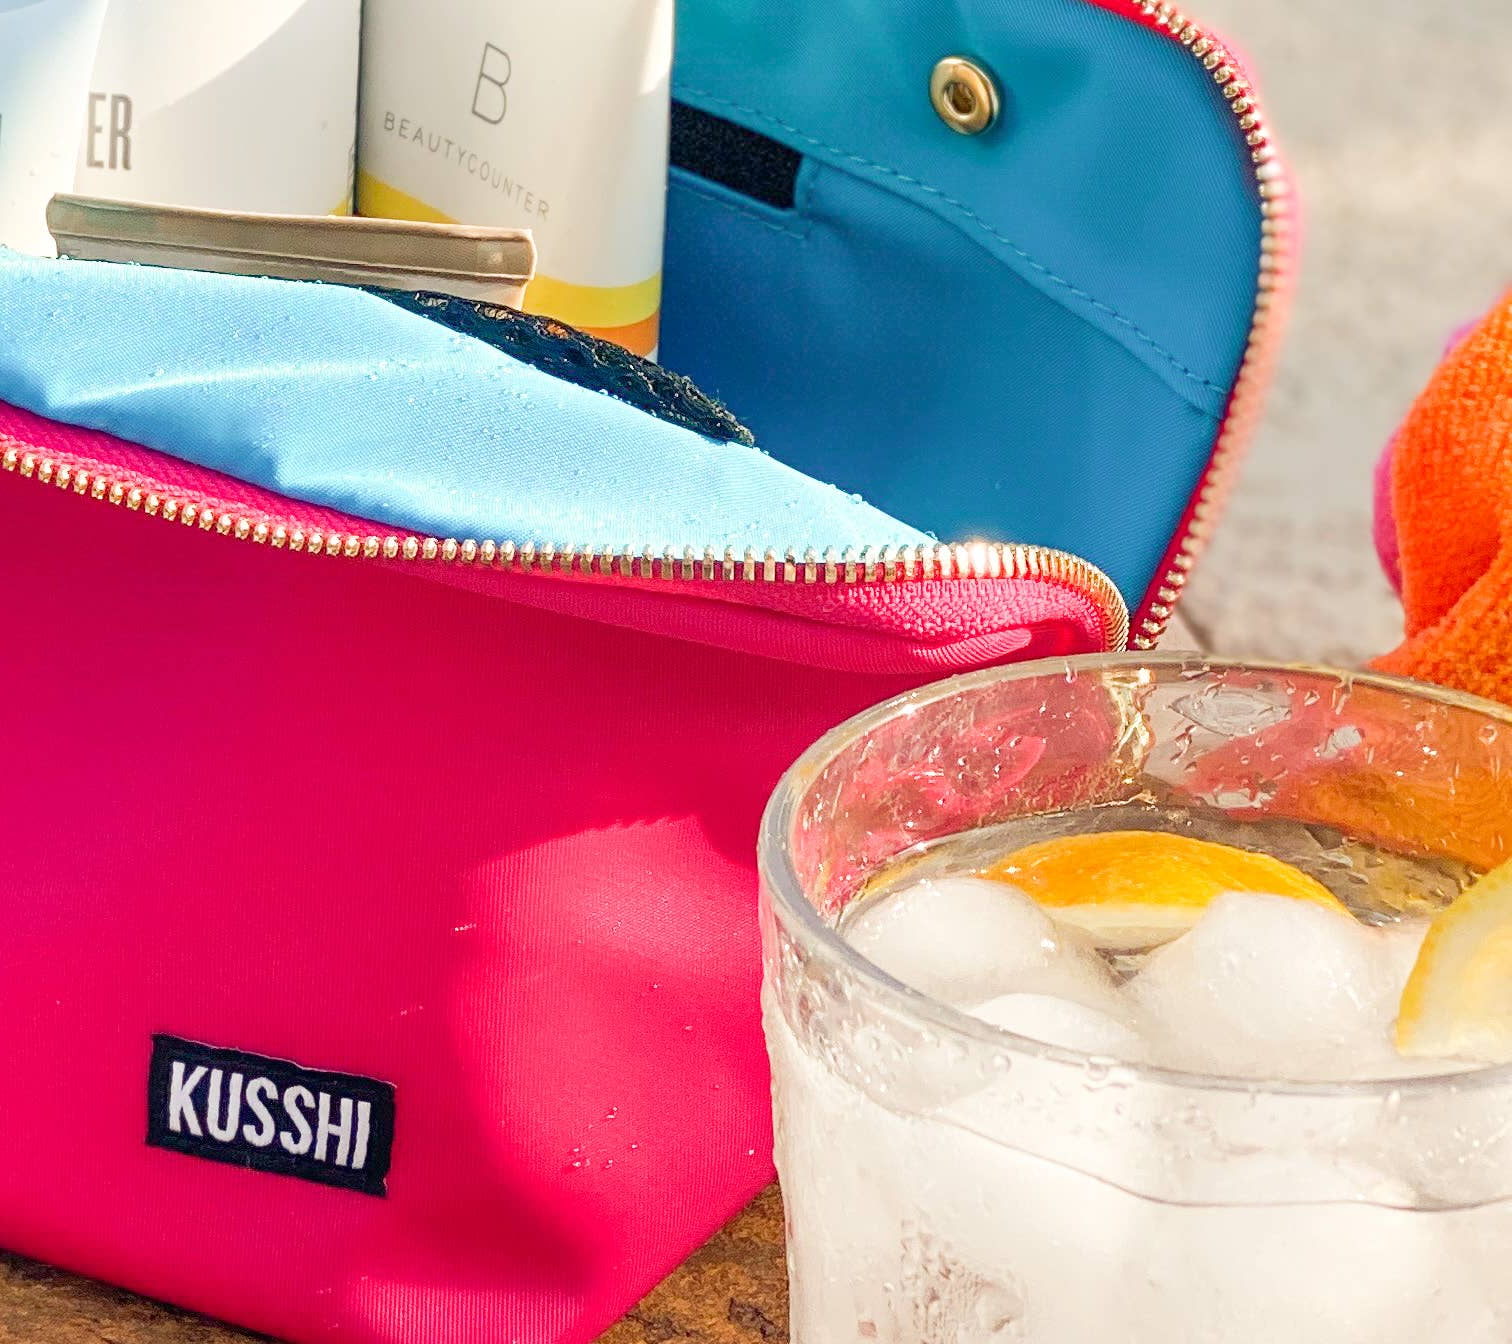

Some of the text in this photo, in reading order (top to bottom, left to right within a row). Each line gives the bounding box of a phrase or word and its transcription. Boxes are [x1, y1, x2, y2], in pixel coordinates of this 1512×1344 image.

[471, 41, 512, 125] B
[383, 111, 551, 222] BEAUTYCOUNTER
[169, 1061, 372, 1171] KUSSHI
